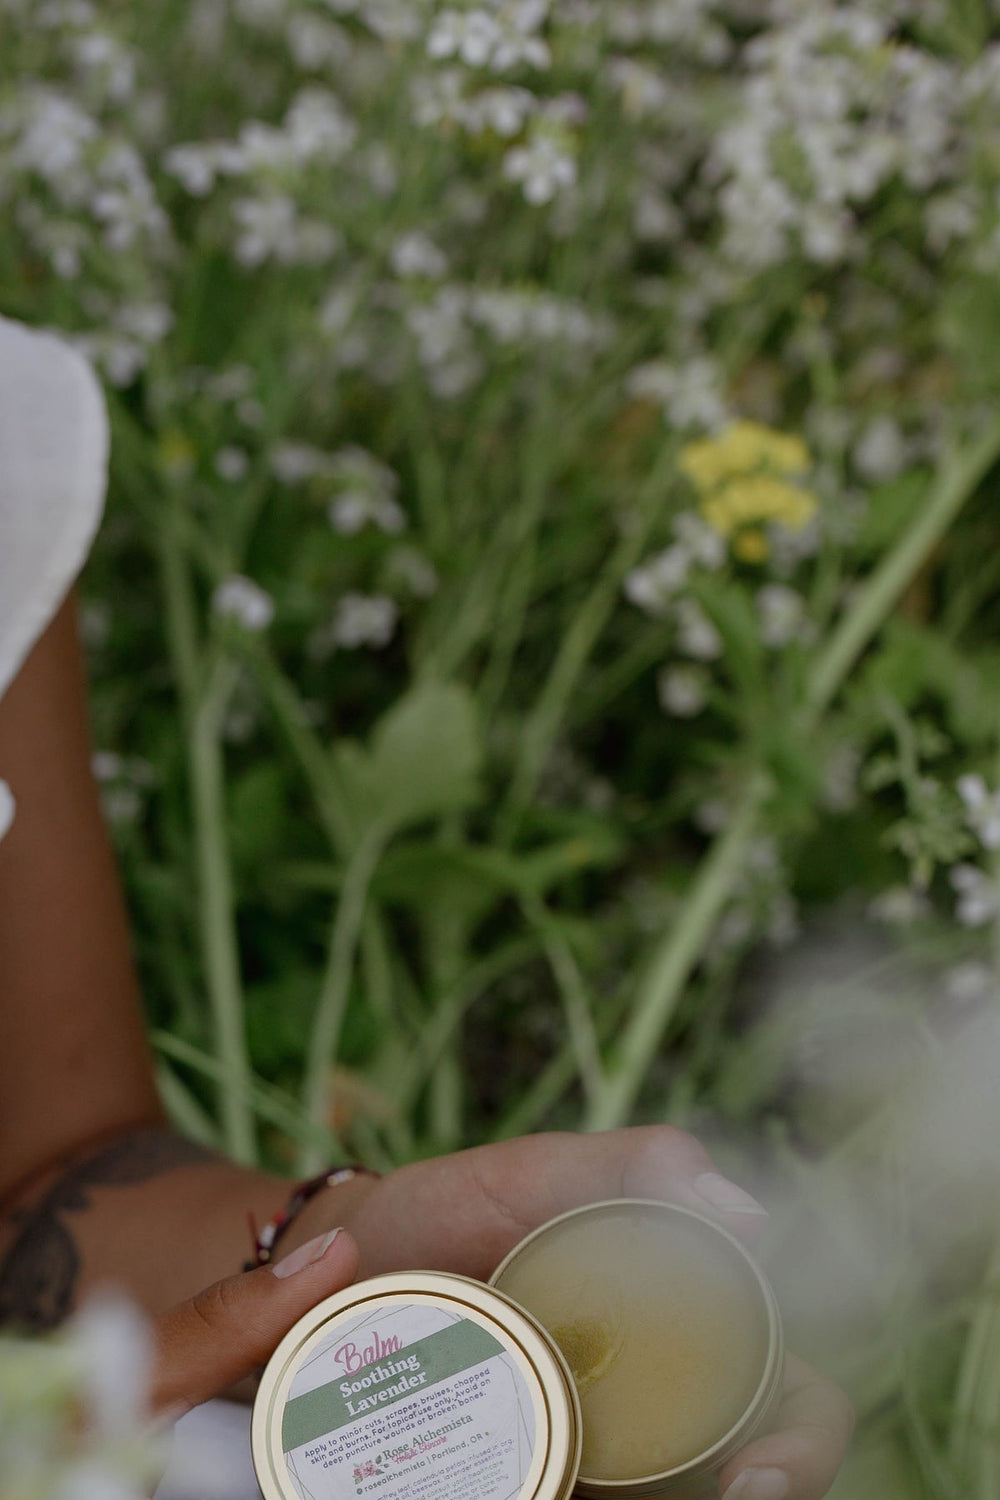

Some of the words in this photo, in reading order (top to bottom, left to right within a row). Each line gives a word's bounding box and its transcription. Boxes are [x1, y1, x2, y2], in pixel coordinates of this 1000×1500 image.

[333, 1330, 403, 1377] Balm
[339, 1353, 420, 1398] Soothing
[304, 1443, 327, 1458] Apply
[328, 1438, 337, 1446] to
[338, 1426, 362, 1442] minor
[364, 1418, 385, 1430] cuts,
[385, 1401, 420, 1421] scrapes,
[420, 1386, 453, 1404] bruises,
[453, 1368, 490, 1389] chapped
[345, 1370, 427, 1416] Lavender
[310, 1453, 327, 1464] skin
[327, 1444, 344, 1456] and
[344, 1433, 371, 1448] burns.
[371, 1425, 386, 1436] For
[387, 1410, 417, 1429] topical
[417, 1405, 432, 1415] use
[455, 1383, 478, 1398] Avoid
[479, 1378, 490, 1387] on
[322, 1455, 343, 1469] deep
[344, 1437, 382, 1460] puncture
[383, 1422, 415, 1440] wounds
[416, 1417, 426, 1425] or
[426, 1403, 457, 1420] broken
[457, 1390, 486, 1406] bones.
[382, 1442, 409, 1460] Rose
[411, 1414, 473, 1447] Alchemista
[364, 1460, 425, 1492] rosealchemista
[431, 1440, 469, 1461] Portland,
[469, 1433, 483, 1443] OR
[412, 1469, 445, 1487] calendula
